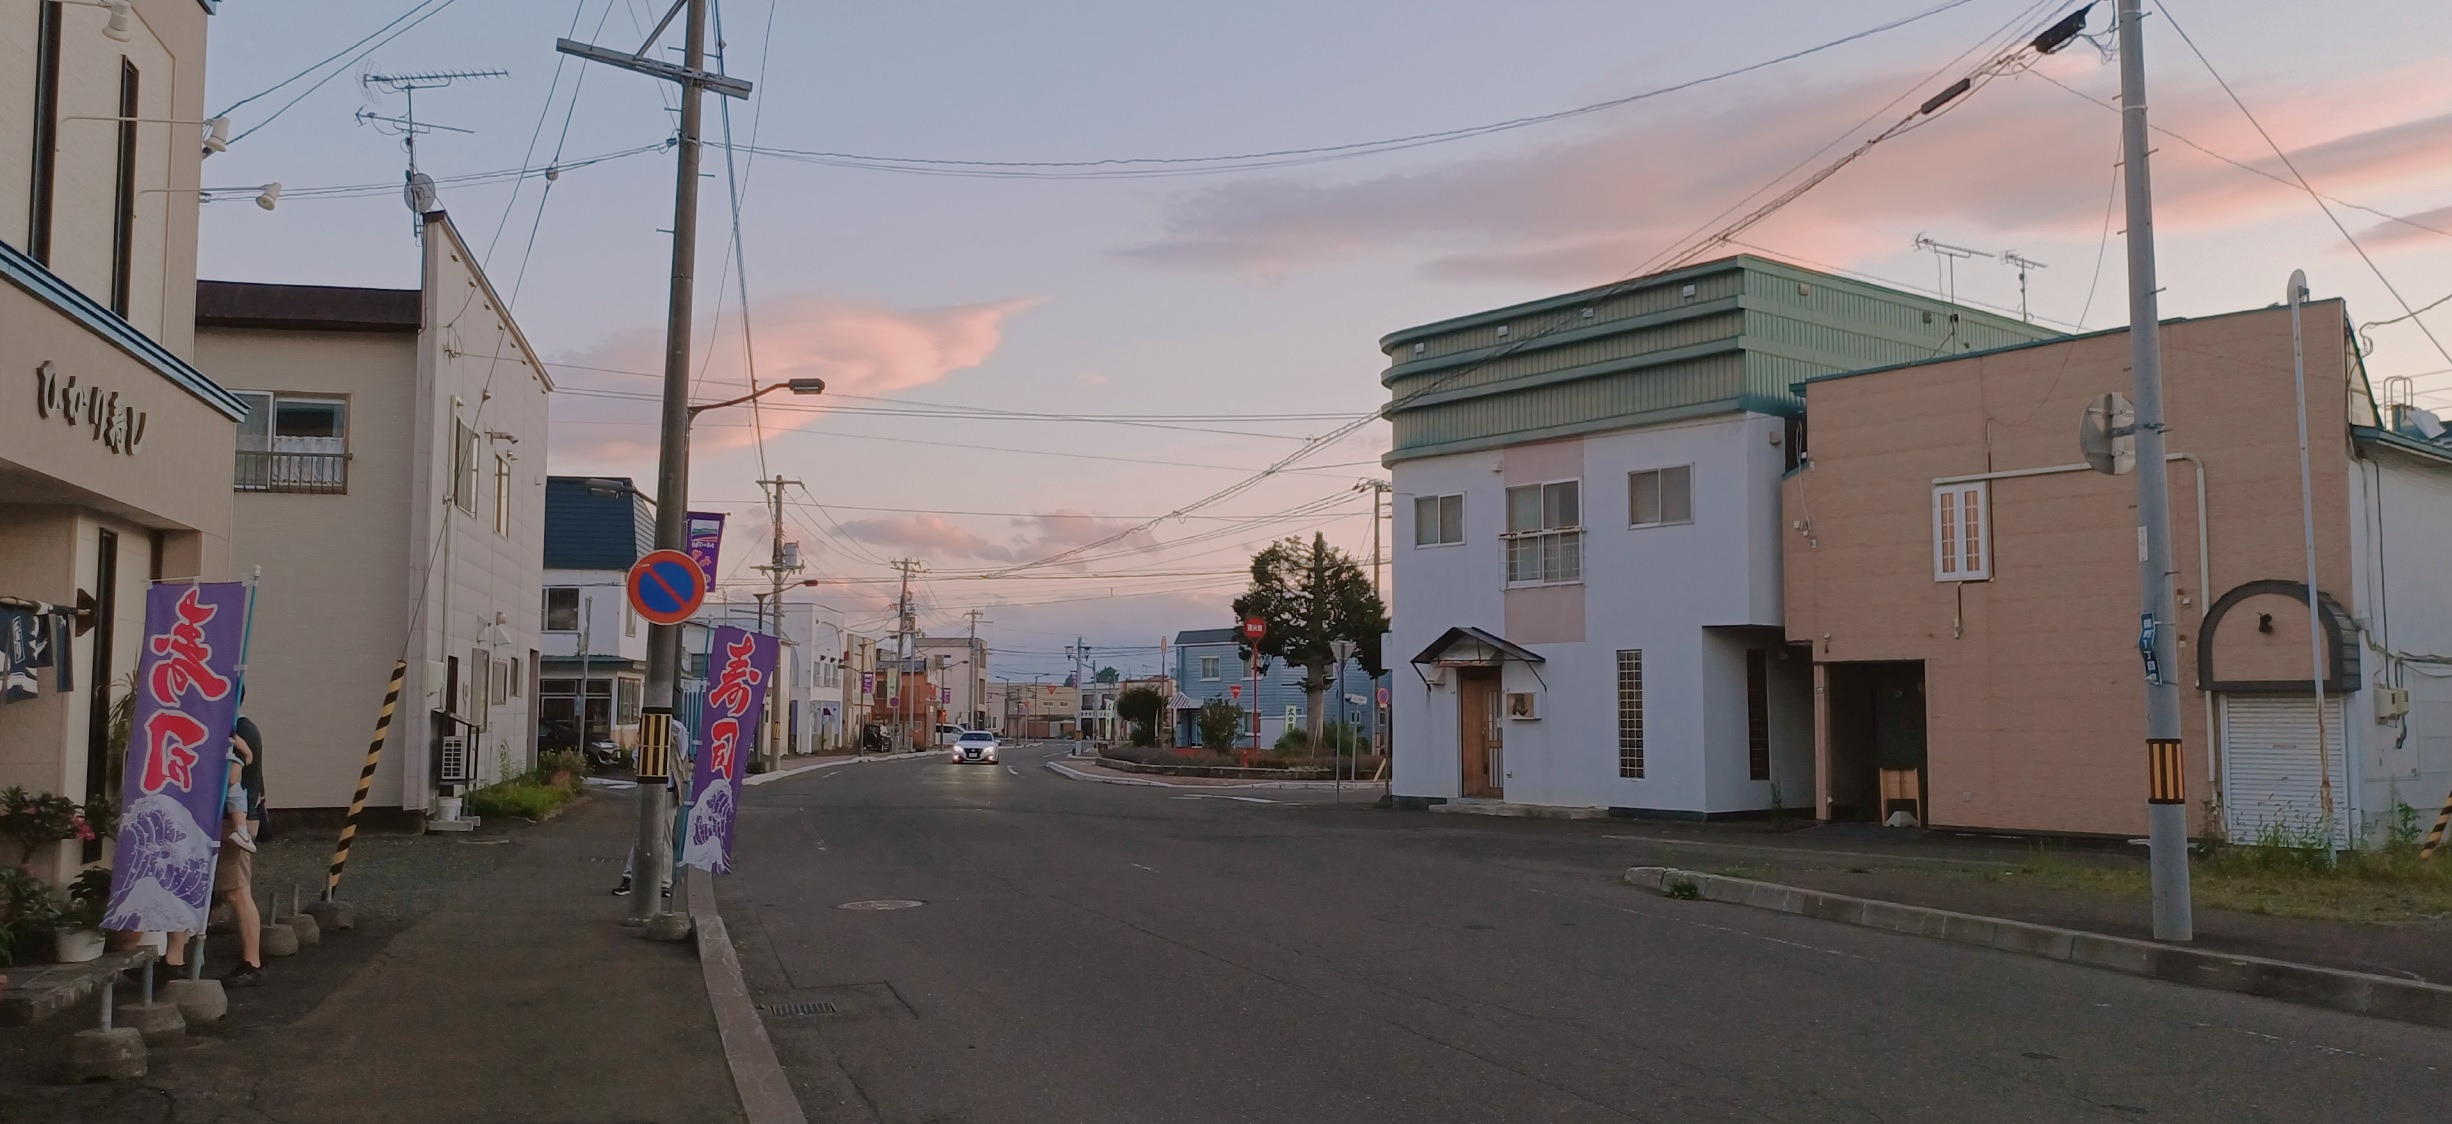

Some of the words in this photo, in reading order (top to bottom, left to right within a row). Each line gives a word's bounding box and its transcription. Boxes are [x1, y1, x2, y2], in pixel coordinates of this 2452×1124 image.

[36, 360, 147, 456] ひかり寿し
[709, 631, 763, 782] 寿司
